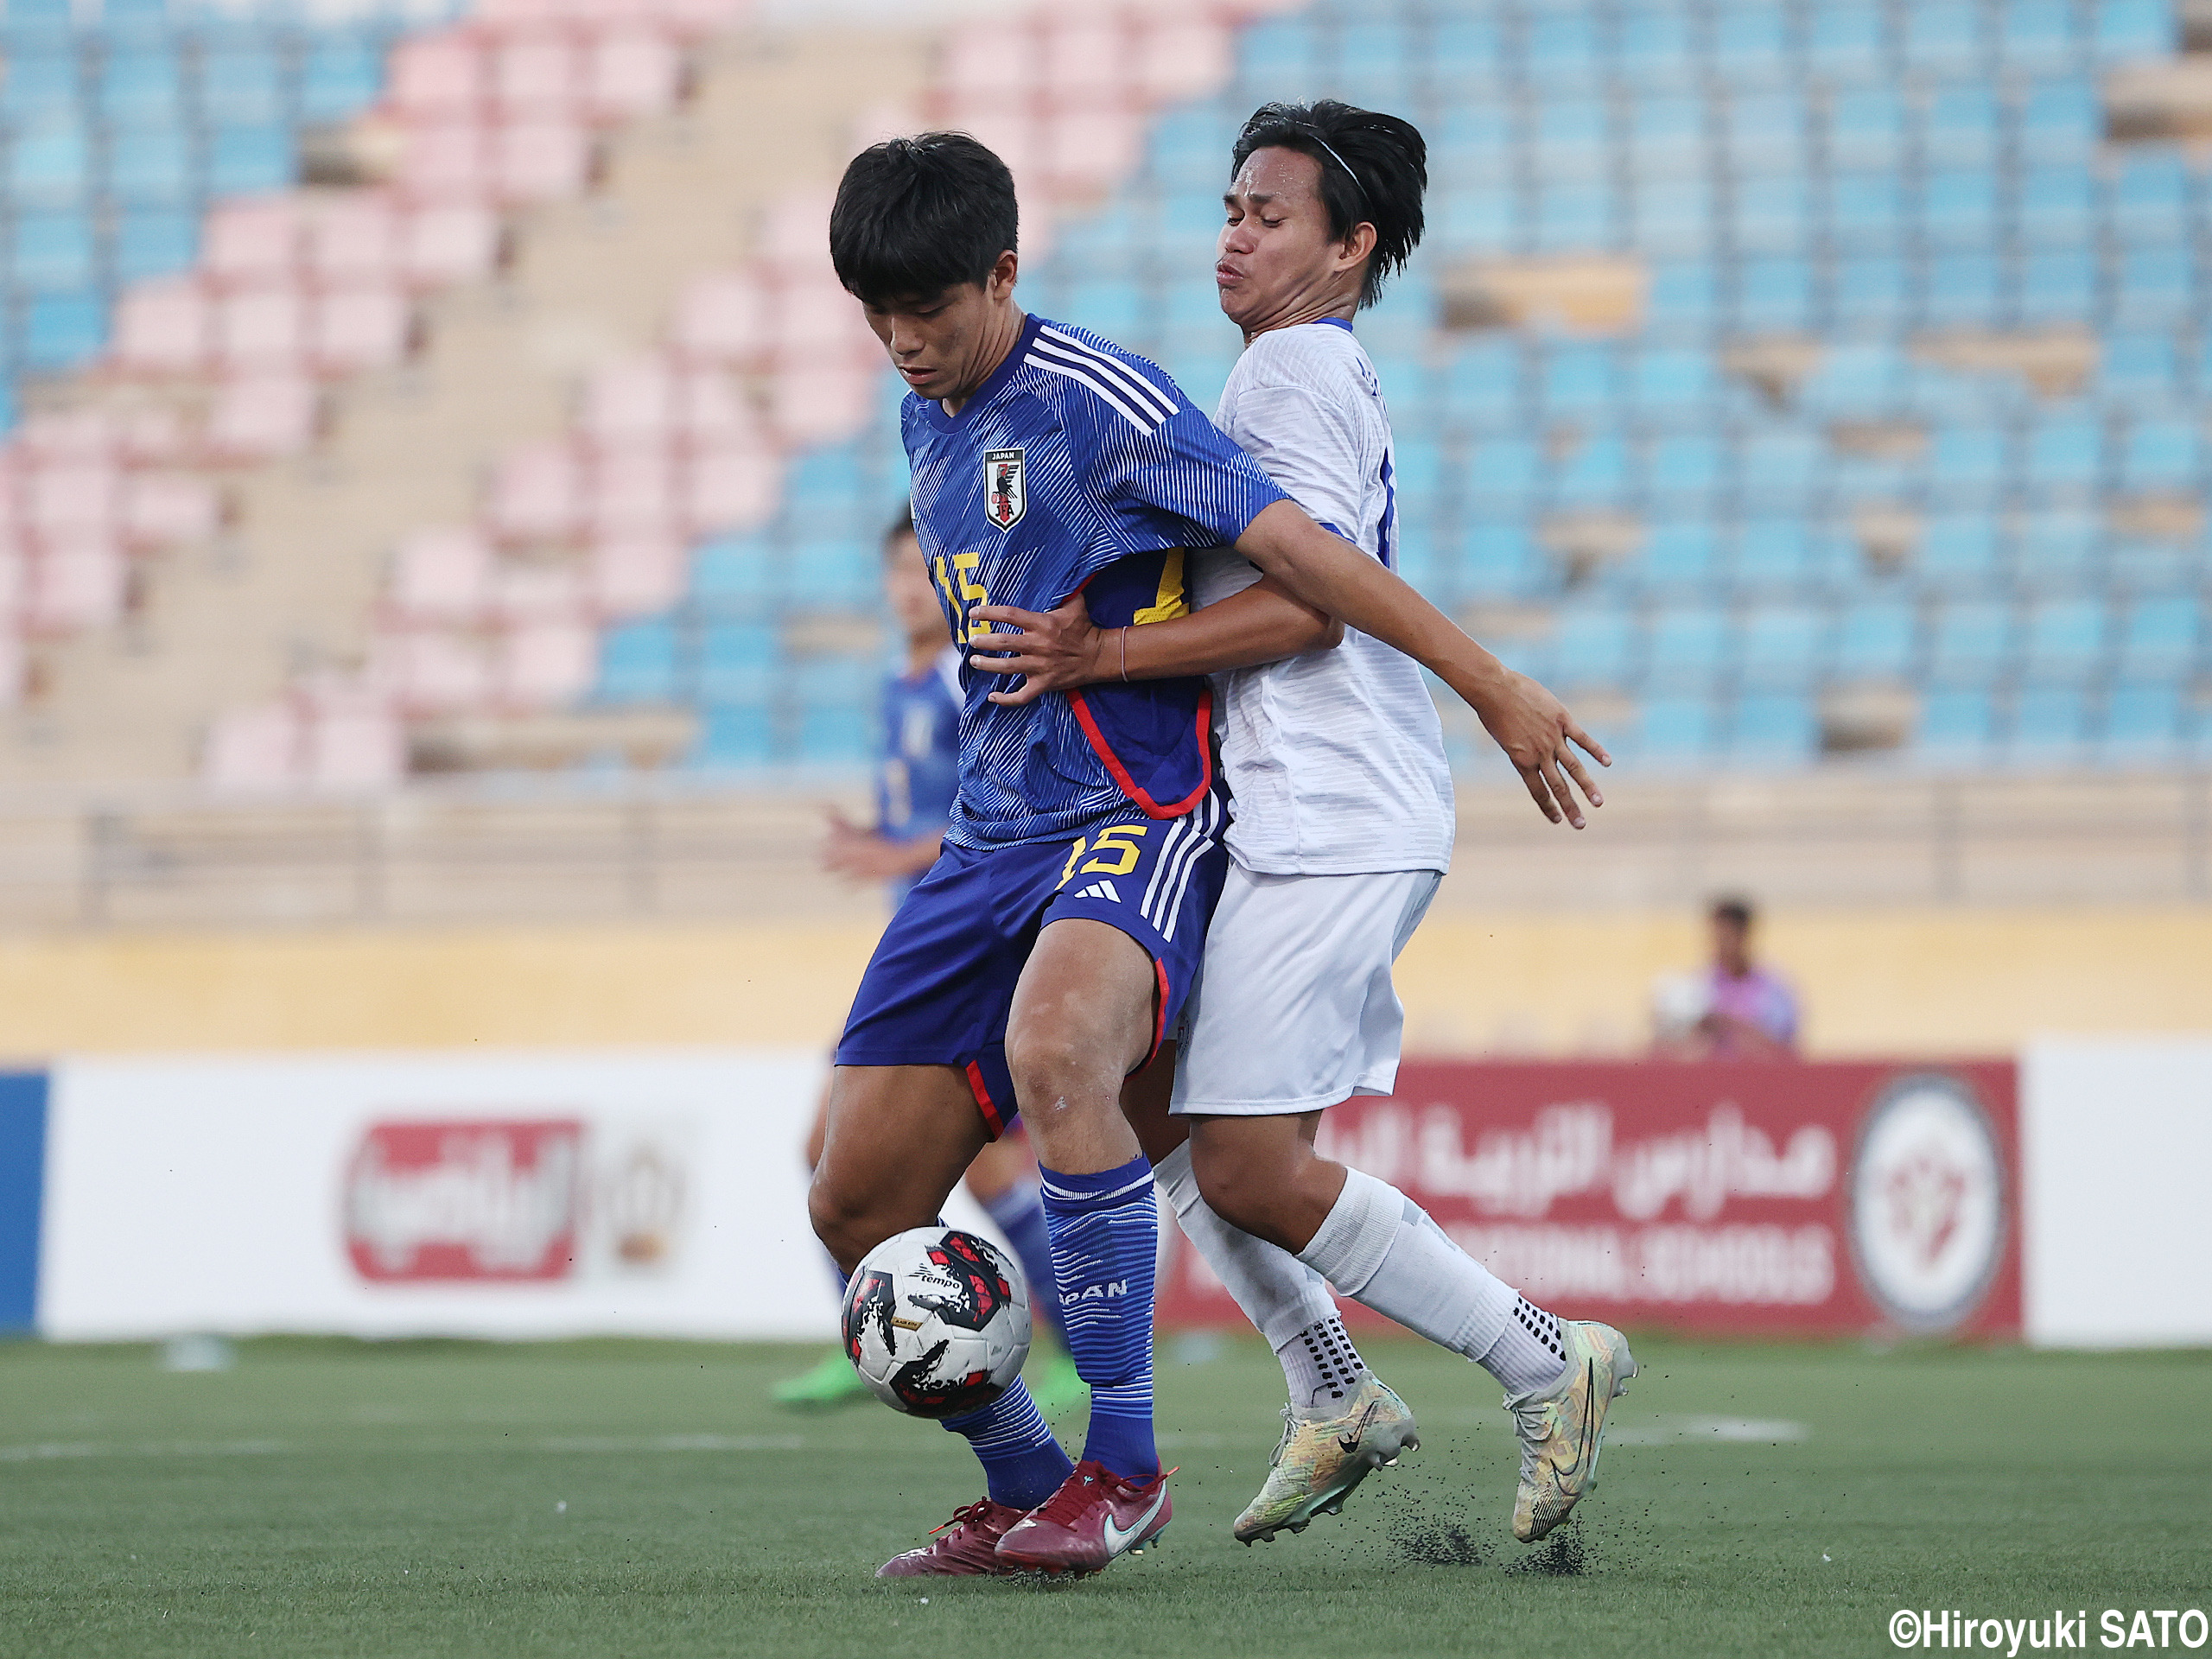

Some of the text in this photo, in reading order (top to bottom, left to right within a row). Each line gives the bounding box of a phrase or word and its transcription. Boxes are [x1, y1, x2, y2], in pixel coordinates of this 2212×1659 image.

[991, 451, 1015, 461] JAPAN
[935, 552, 993, 644] 15
[1054, 823, 1148, 891] 15
[921, 1274, 961, 1289] tempo
[1058, 1278, 1129, 1306] APAN
